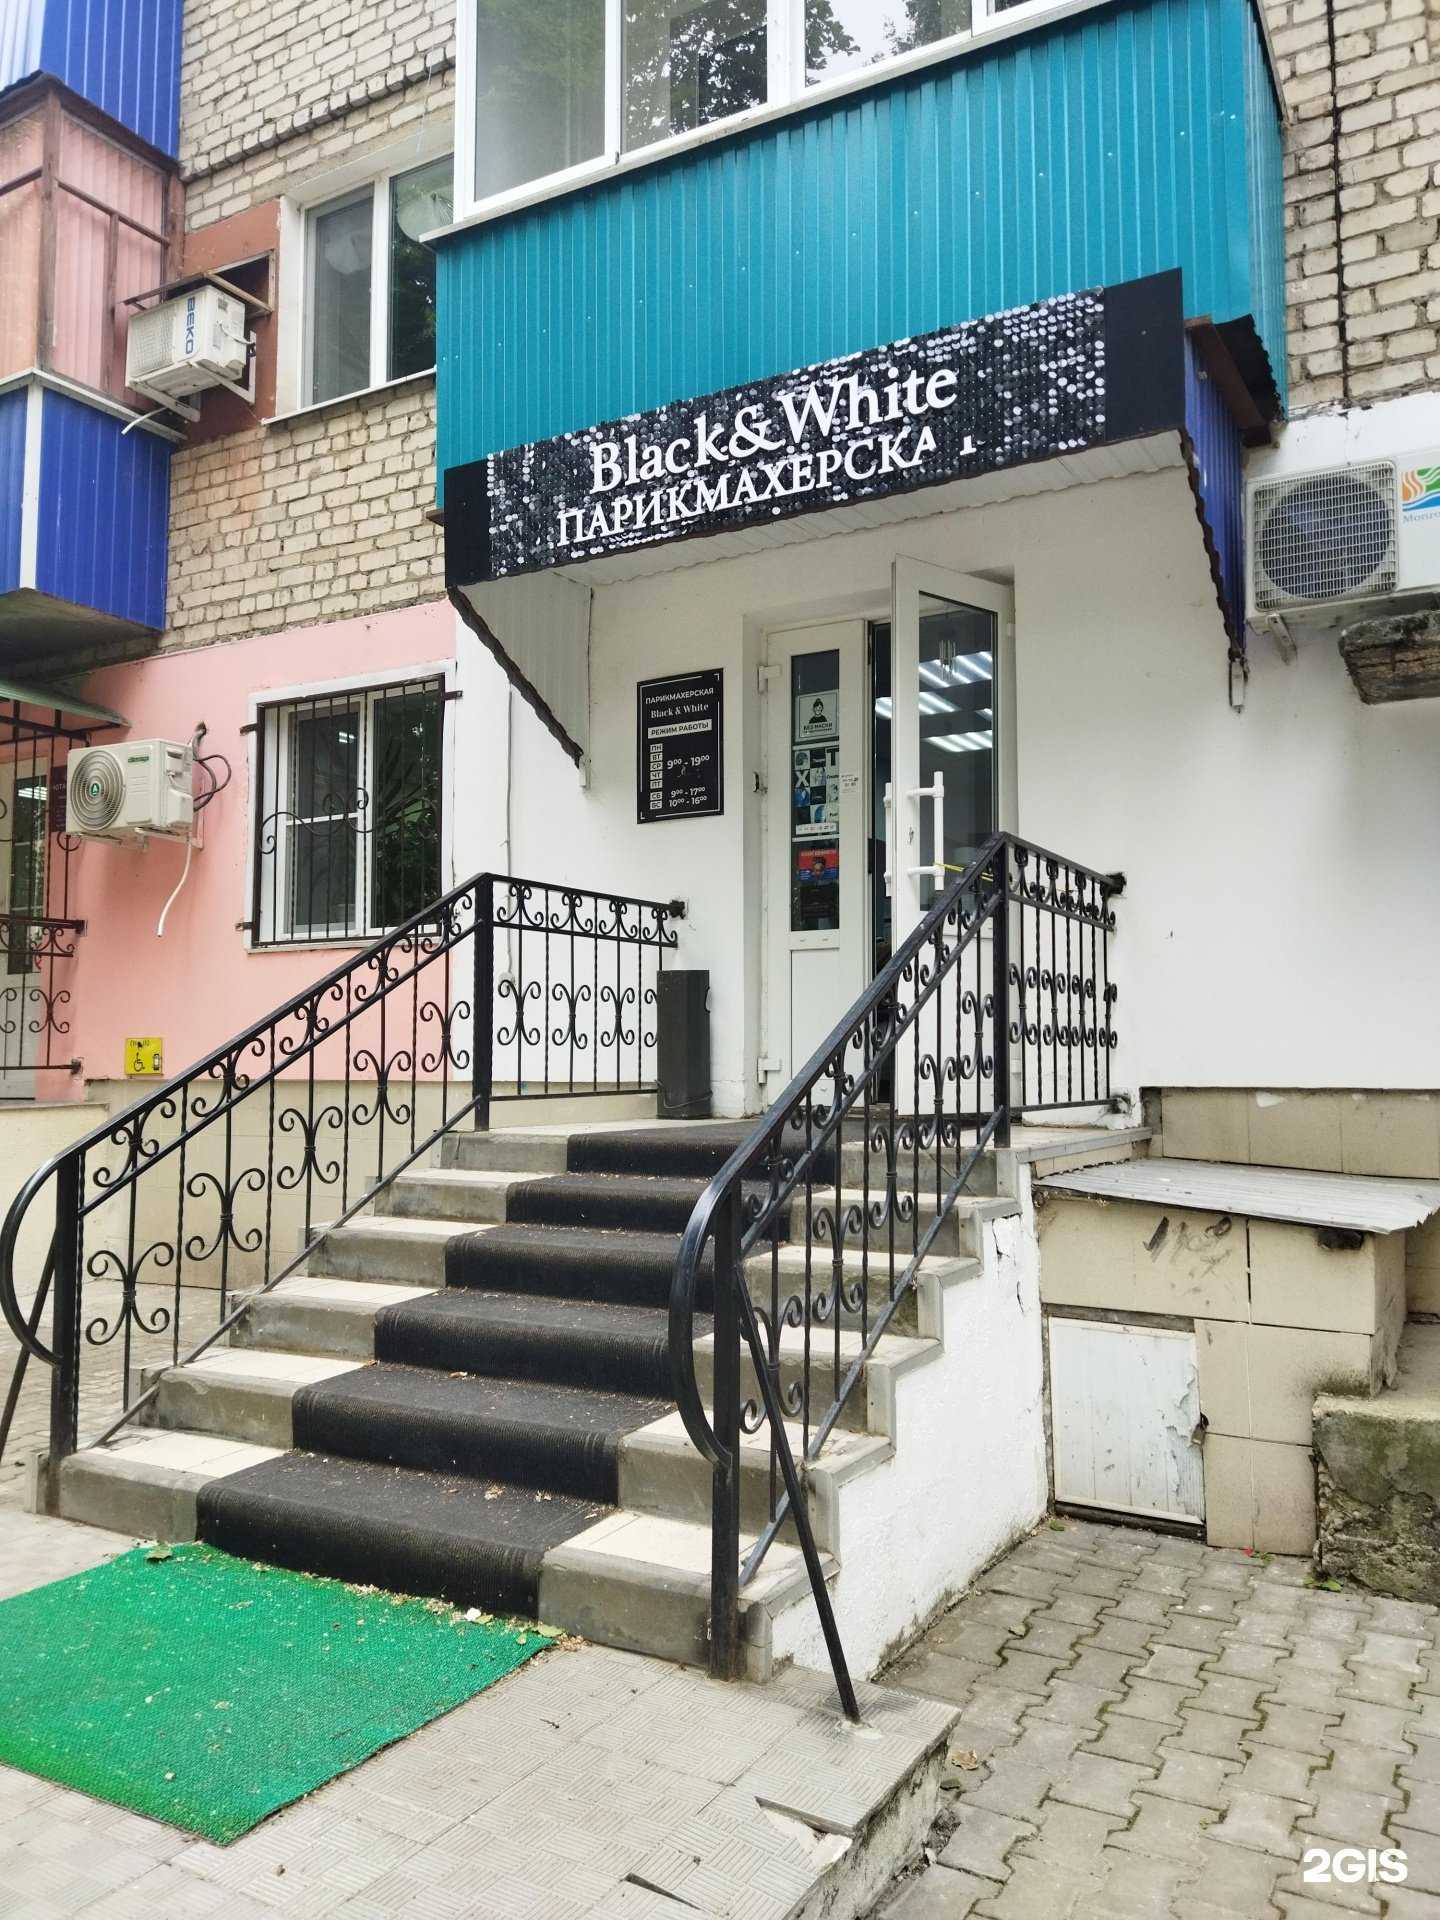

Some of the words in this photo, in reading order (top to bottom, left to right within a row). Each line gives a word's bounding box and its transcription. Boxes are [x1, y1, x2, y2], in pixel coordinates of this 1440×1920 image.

[185, 296, 196, 355] BEKO
[589, 368, 958, 495] Black&White
[645, 687, 714, 705] ПАРИКМАХЕРСКАЯ
[650, 707, 674, 719] Black
[675, 706, 681, 715] &
[683, 703, 709, 713] White
[651, 727, 677, 736] РЕЖИМ
[678, 722, 709, 732] РАБОТЫ
